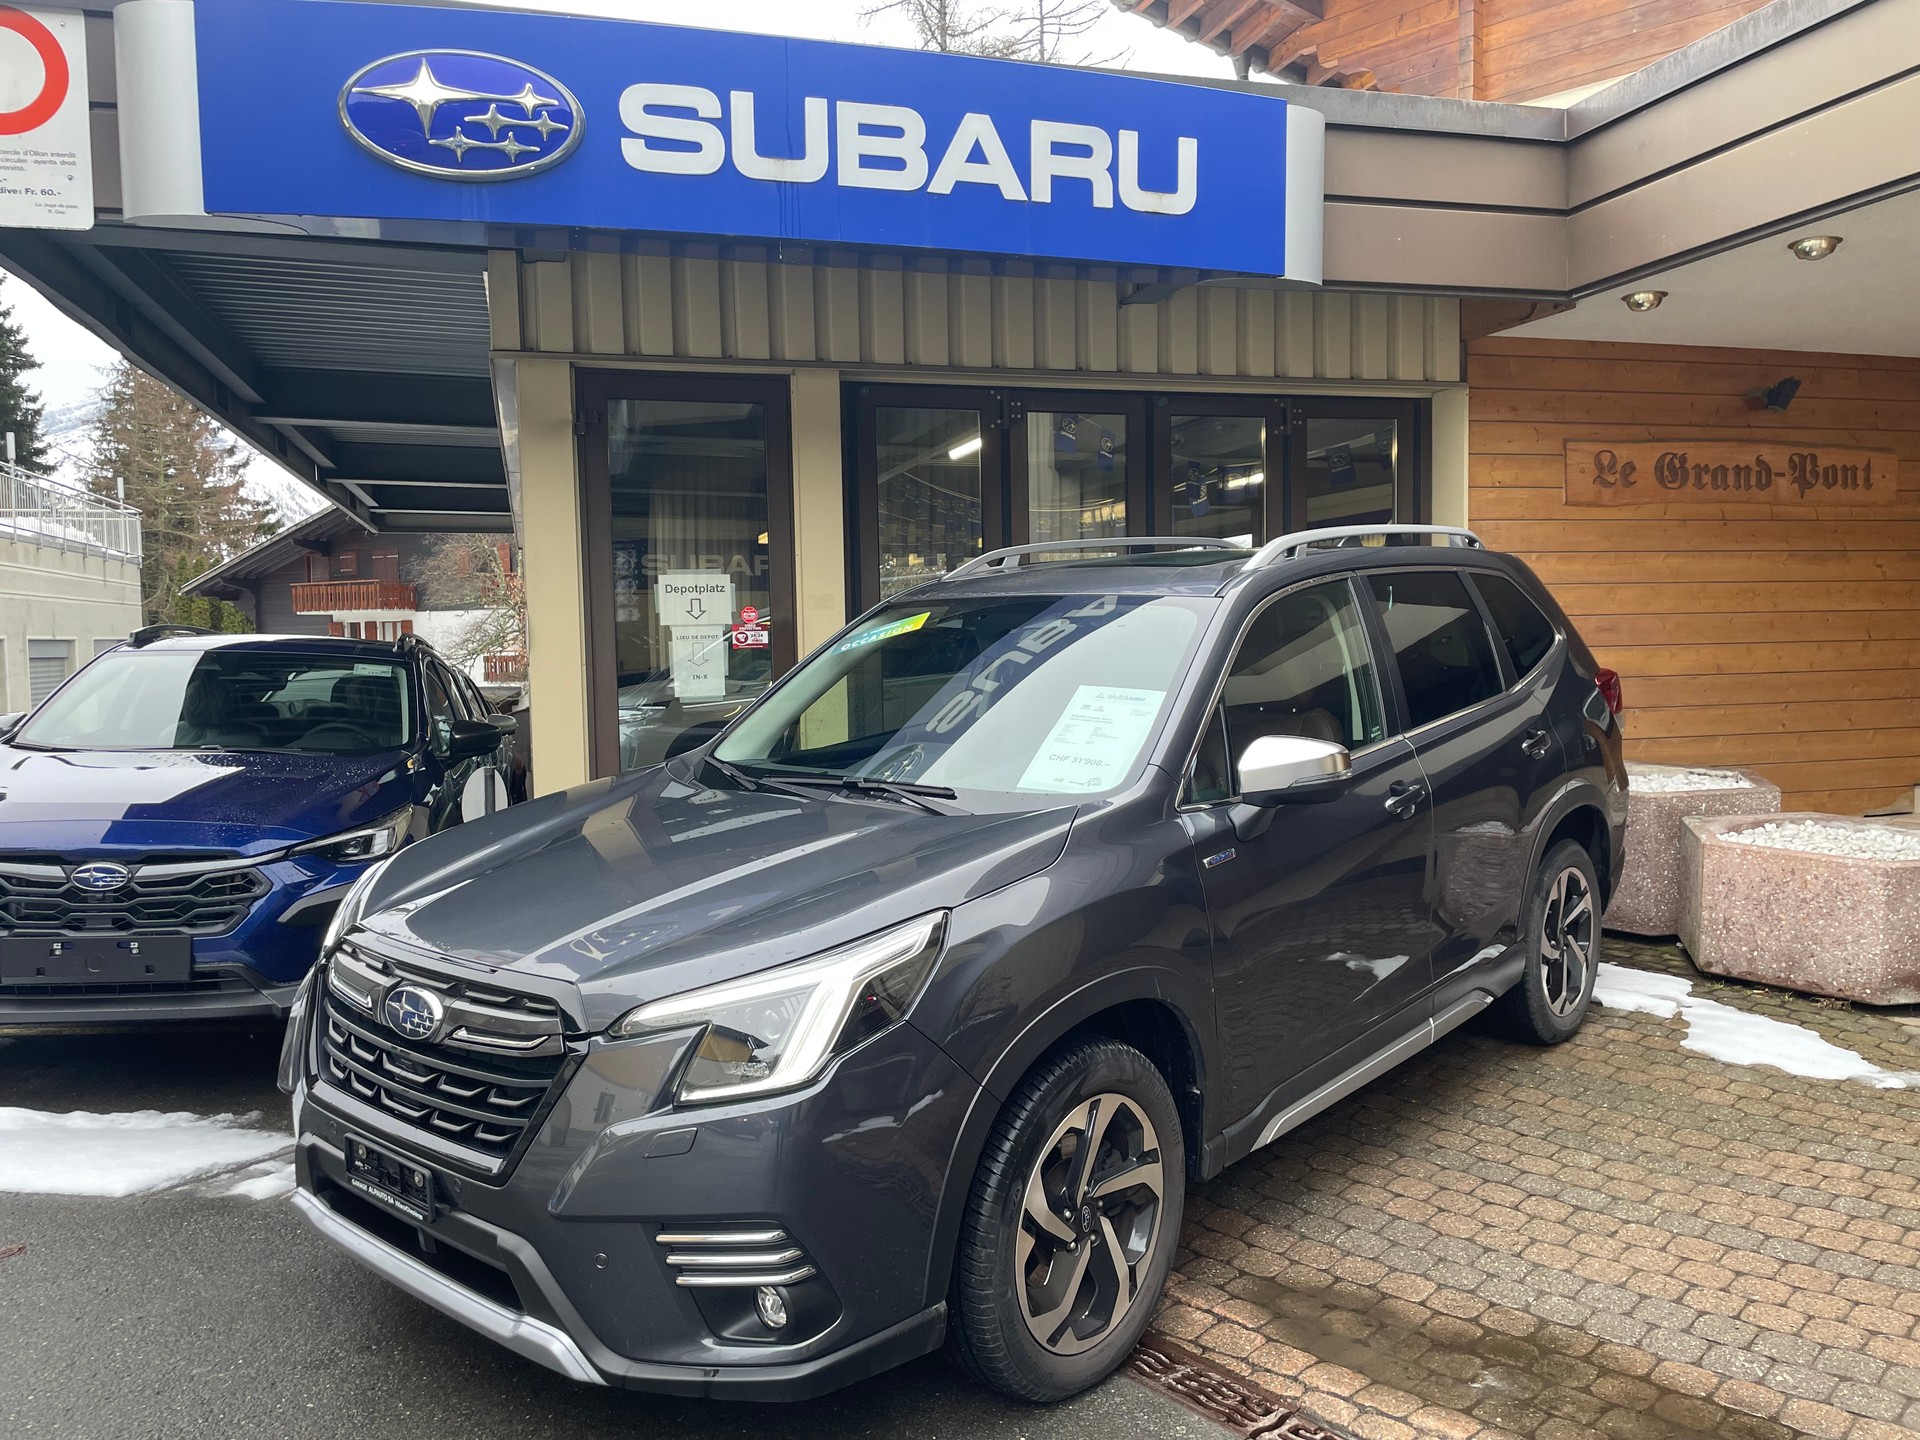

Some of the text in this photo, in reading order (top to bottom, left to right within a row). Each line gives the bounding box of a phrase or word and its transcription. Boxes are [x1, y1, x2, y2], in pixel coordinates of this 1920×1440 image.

[23, 149, 48, 157] d'Ollon
[50, 151, 76, 159] interdit
[618, 82, 1198, 216] SUBARU
[1592, 449, 1875, 500] Le Grand-Pont
[664, 583, 726, 595] Depotplatz
[840, 623, 915, 652] OCCASION
[1049, 753, 1071, 763] CHF
